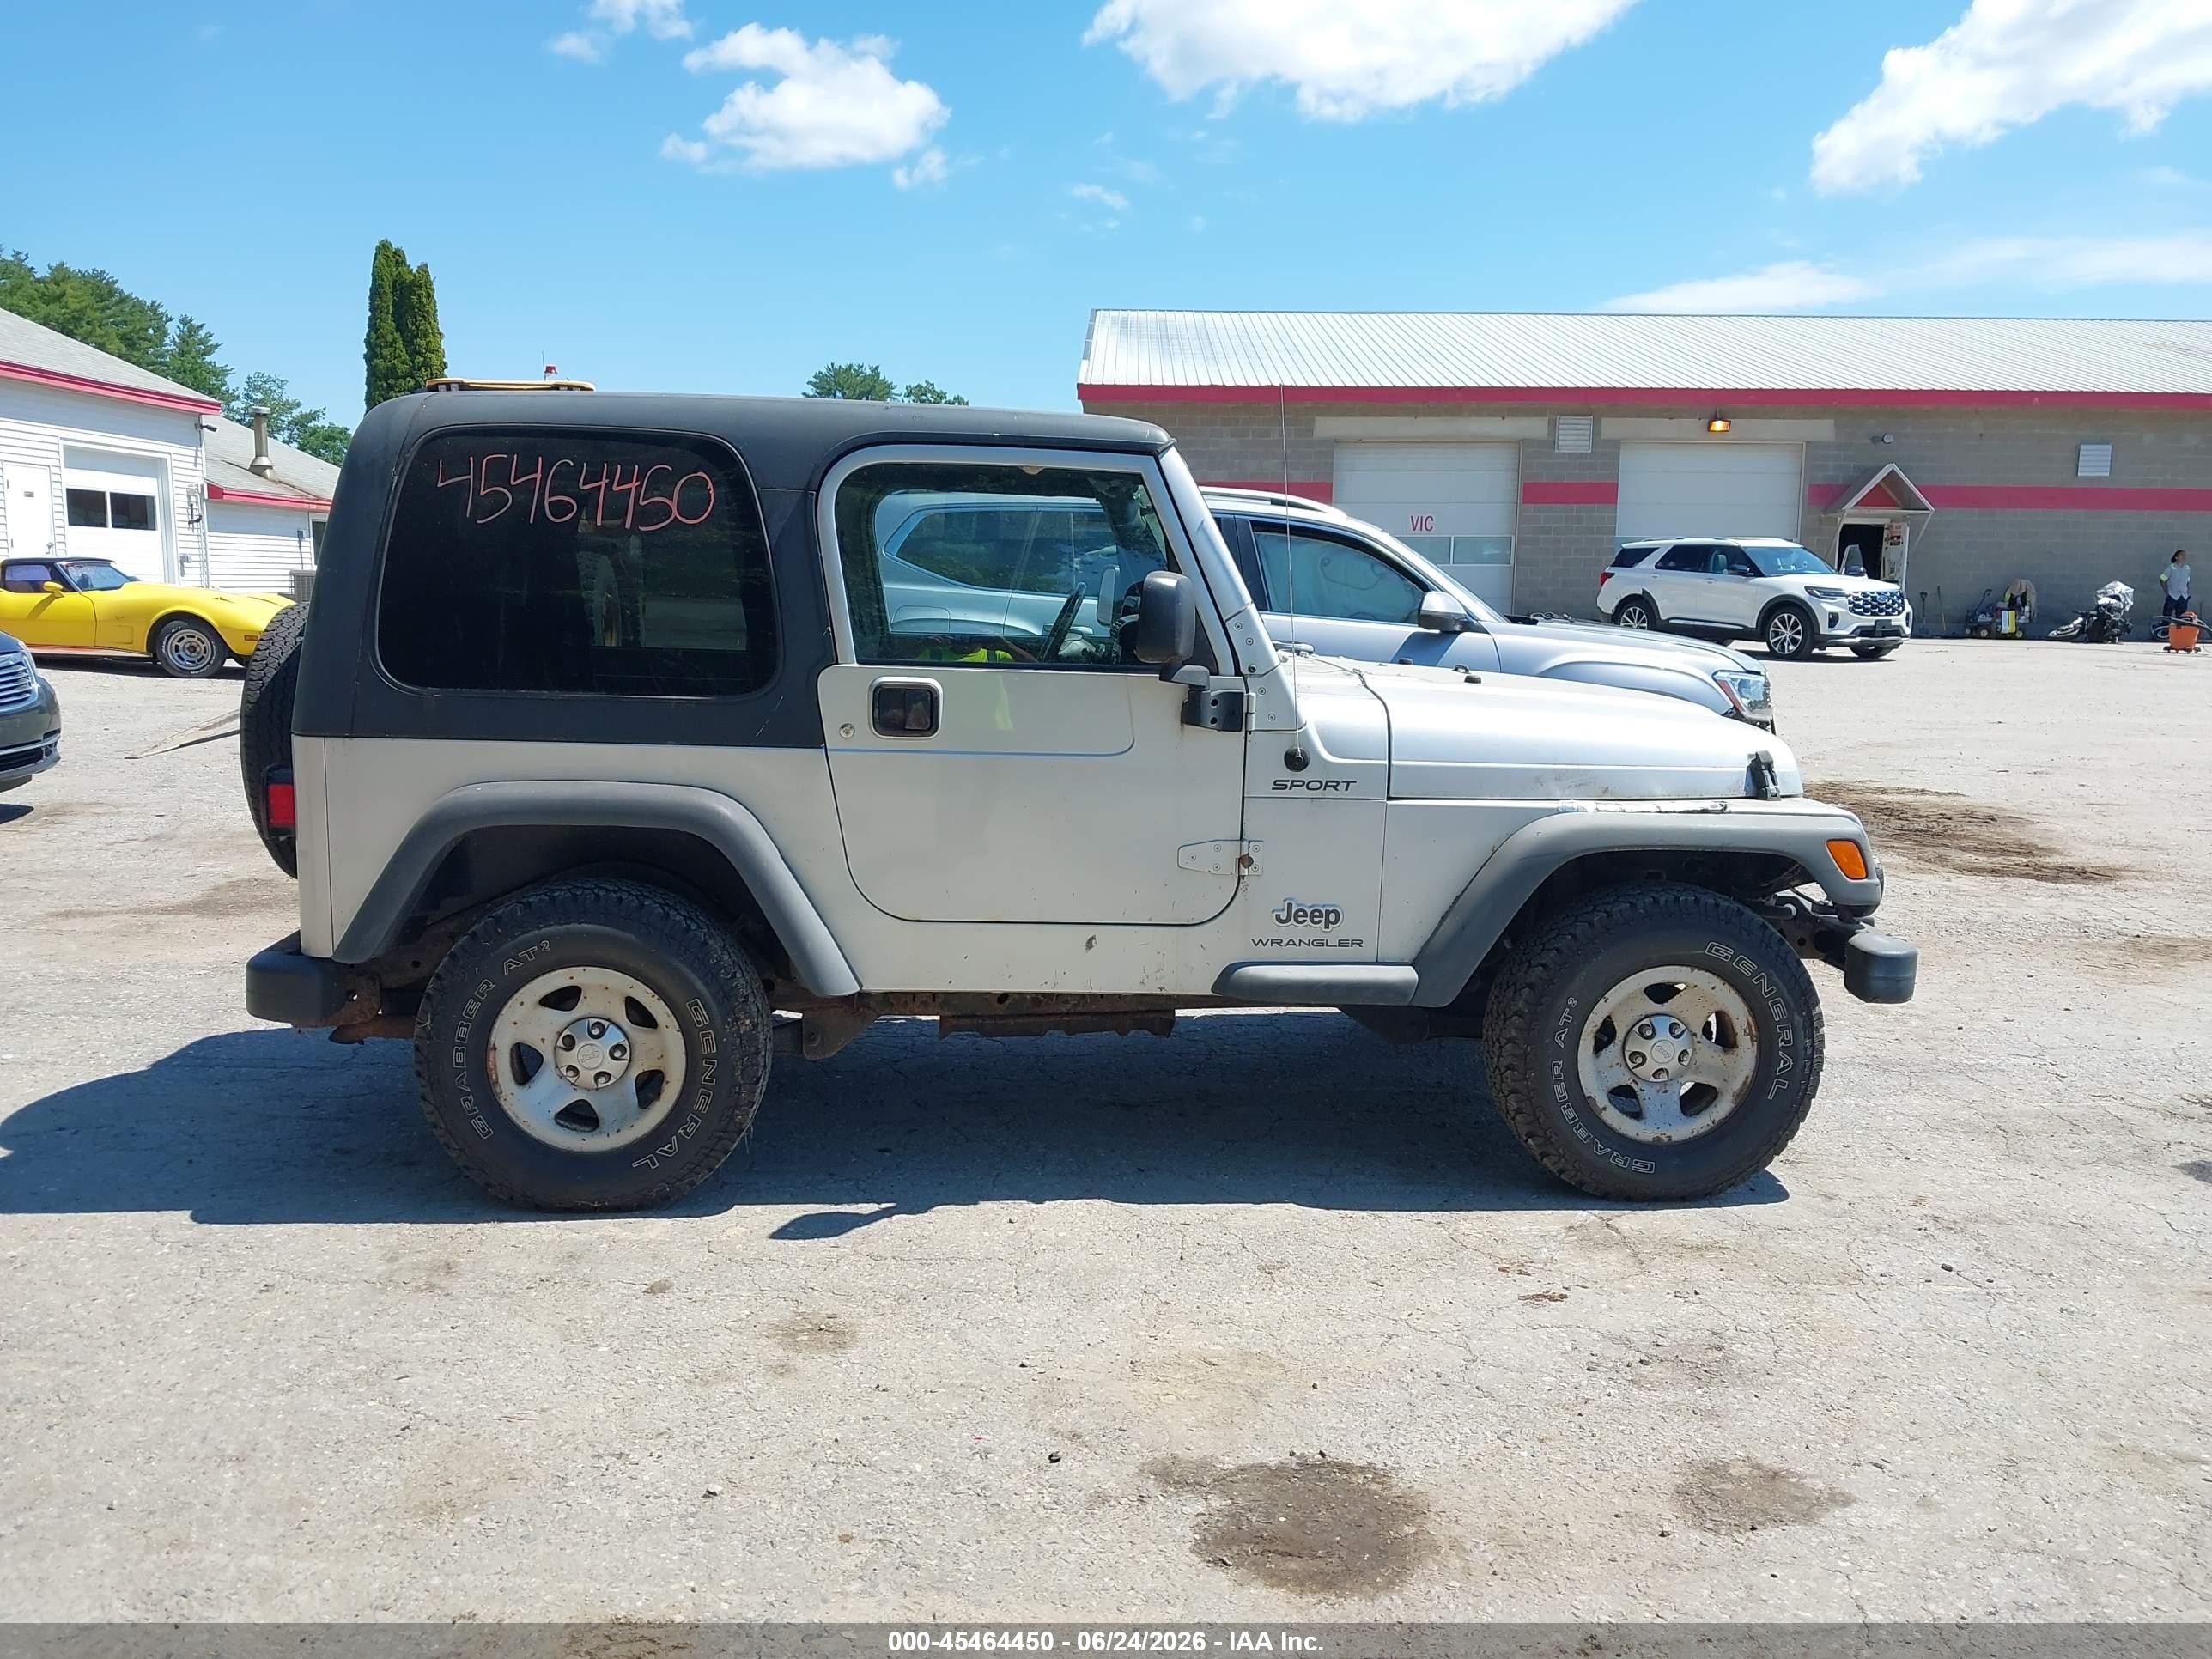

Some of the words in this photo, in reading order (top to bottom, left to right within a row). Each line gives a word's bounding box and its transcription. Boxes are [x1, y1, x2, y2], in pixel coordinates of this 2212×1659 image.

[436, 453, 715, 532] 45464450
[1410, 515, 1434, 532] VIC
[1271, 779, 1358, 792] SPORT
[1251, 938, 1364, 948] WRANGLER
[1273, 900, 1343, 931] Jeep
[453, 978, 495, 1139] GRABBER
[1705, 941, 1795, 1100] GENERAL
[632, 998, 718, 1170] GENERAL
[1551, 1060, 1656, 1175] GRABBER
